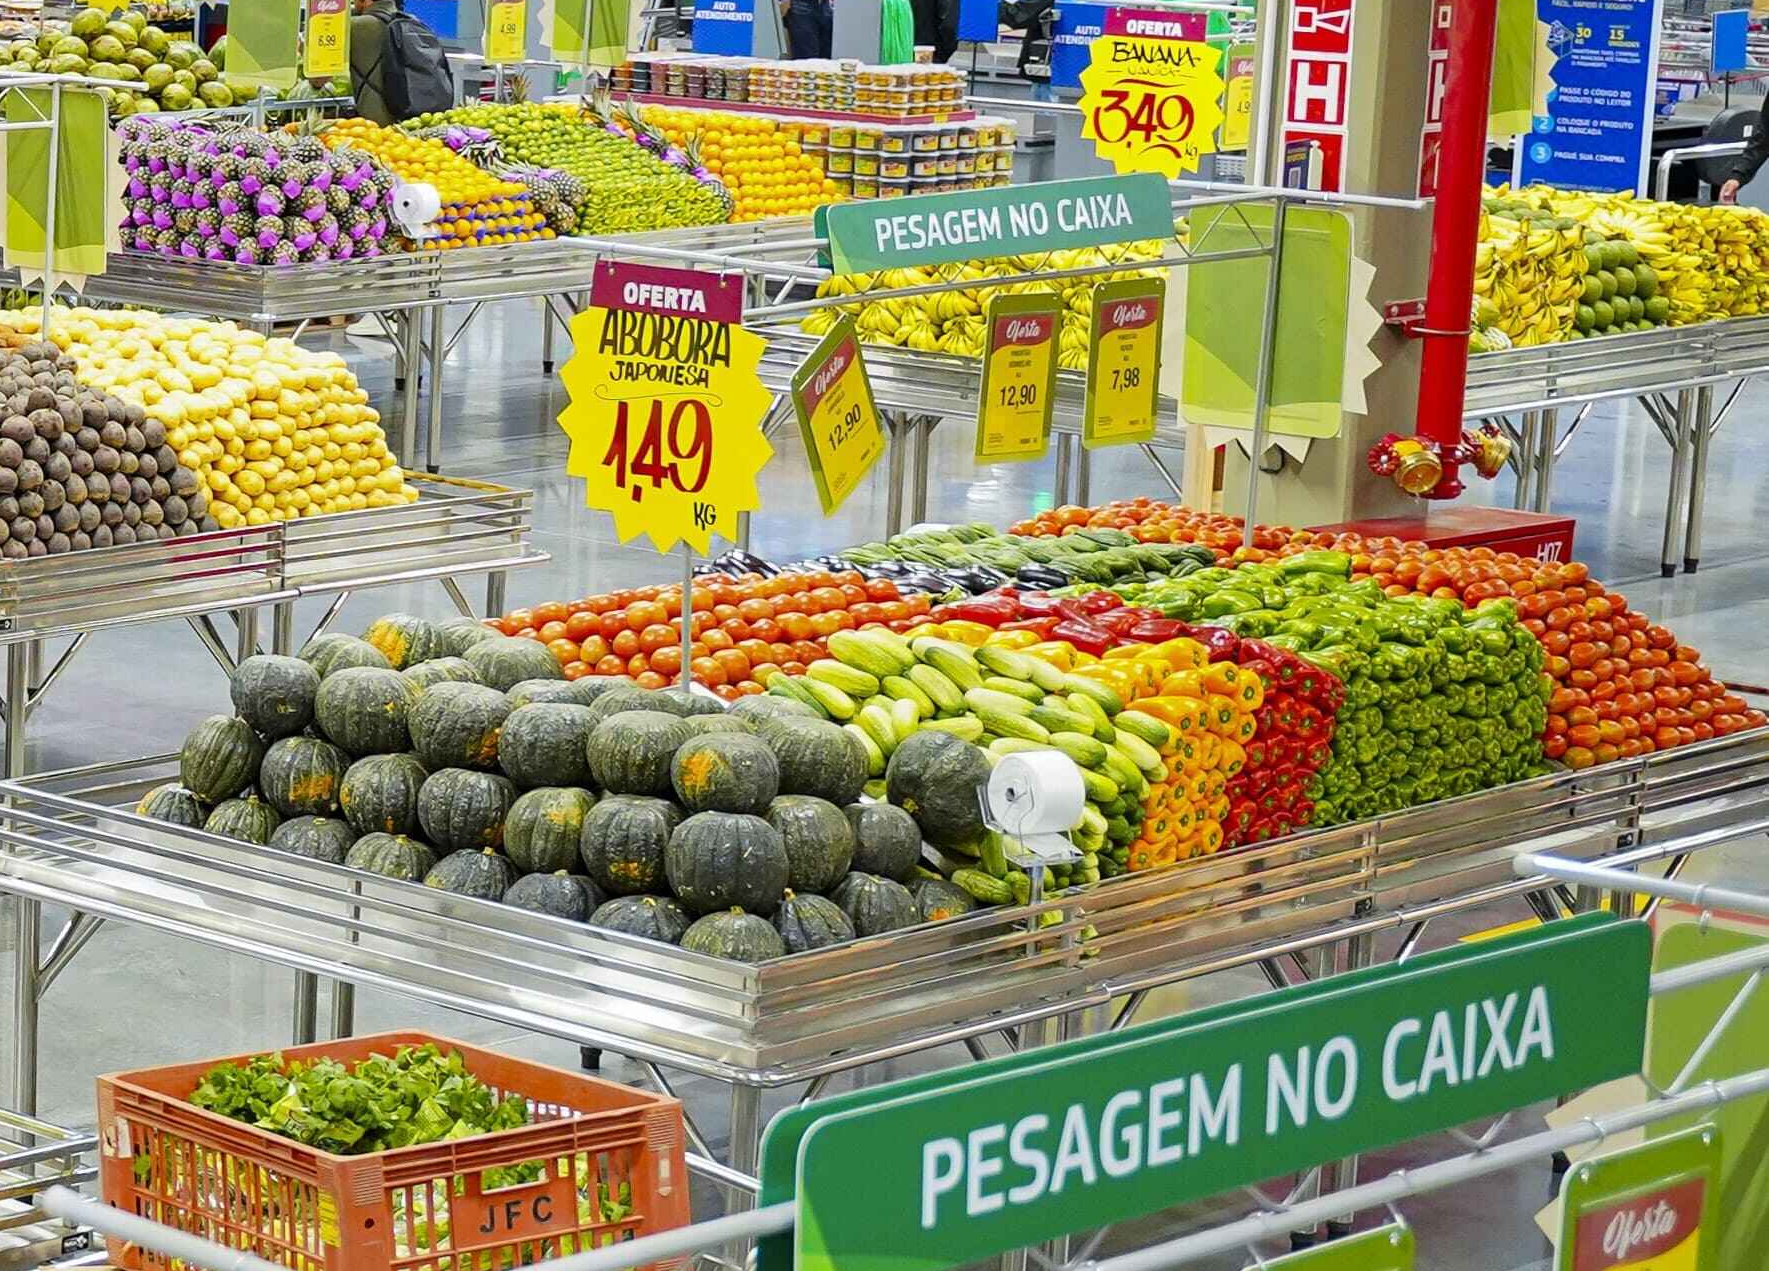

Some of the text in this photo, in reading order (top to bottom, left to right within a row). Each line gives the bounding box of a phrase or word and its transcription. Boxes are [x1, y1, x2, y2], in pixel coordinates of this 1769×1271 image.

[696, 10, 753, 22] ATENDIMENTO
[713, 1, 735, 10] AUTO
[1075, 25, 1101, 35] AUTO
[1127, 19, 1182, 37] OFERTA
[1111, 42, 1200, 67] BANANA
[1293, 62, 1340, 123] H
[1093, 90, 1194, 150] 3,49
[874, 193, 1133, 252] PESAGEM NO CAIXA
[623, 282, 706, 313] OFERTA
[599, 310, 730, 368] ABOBORA
[610, 360, 709, 388] JAPONESA
[1112, 367, 1139, 393] 7,98
[1000, 384, 1037, 407] 12,90
[827, 403, 862, 451] 12,90
[602, 399, 712, 503] 1,49
[694, 502, 716, 531] KG
[919, 984, 1554, 1229] PESAGEM NO CAIXA
[1602, 1198, 1678, 1264] Oferta
